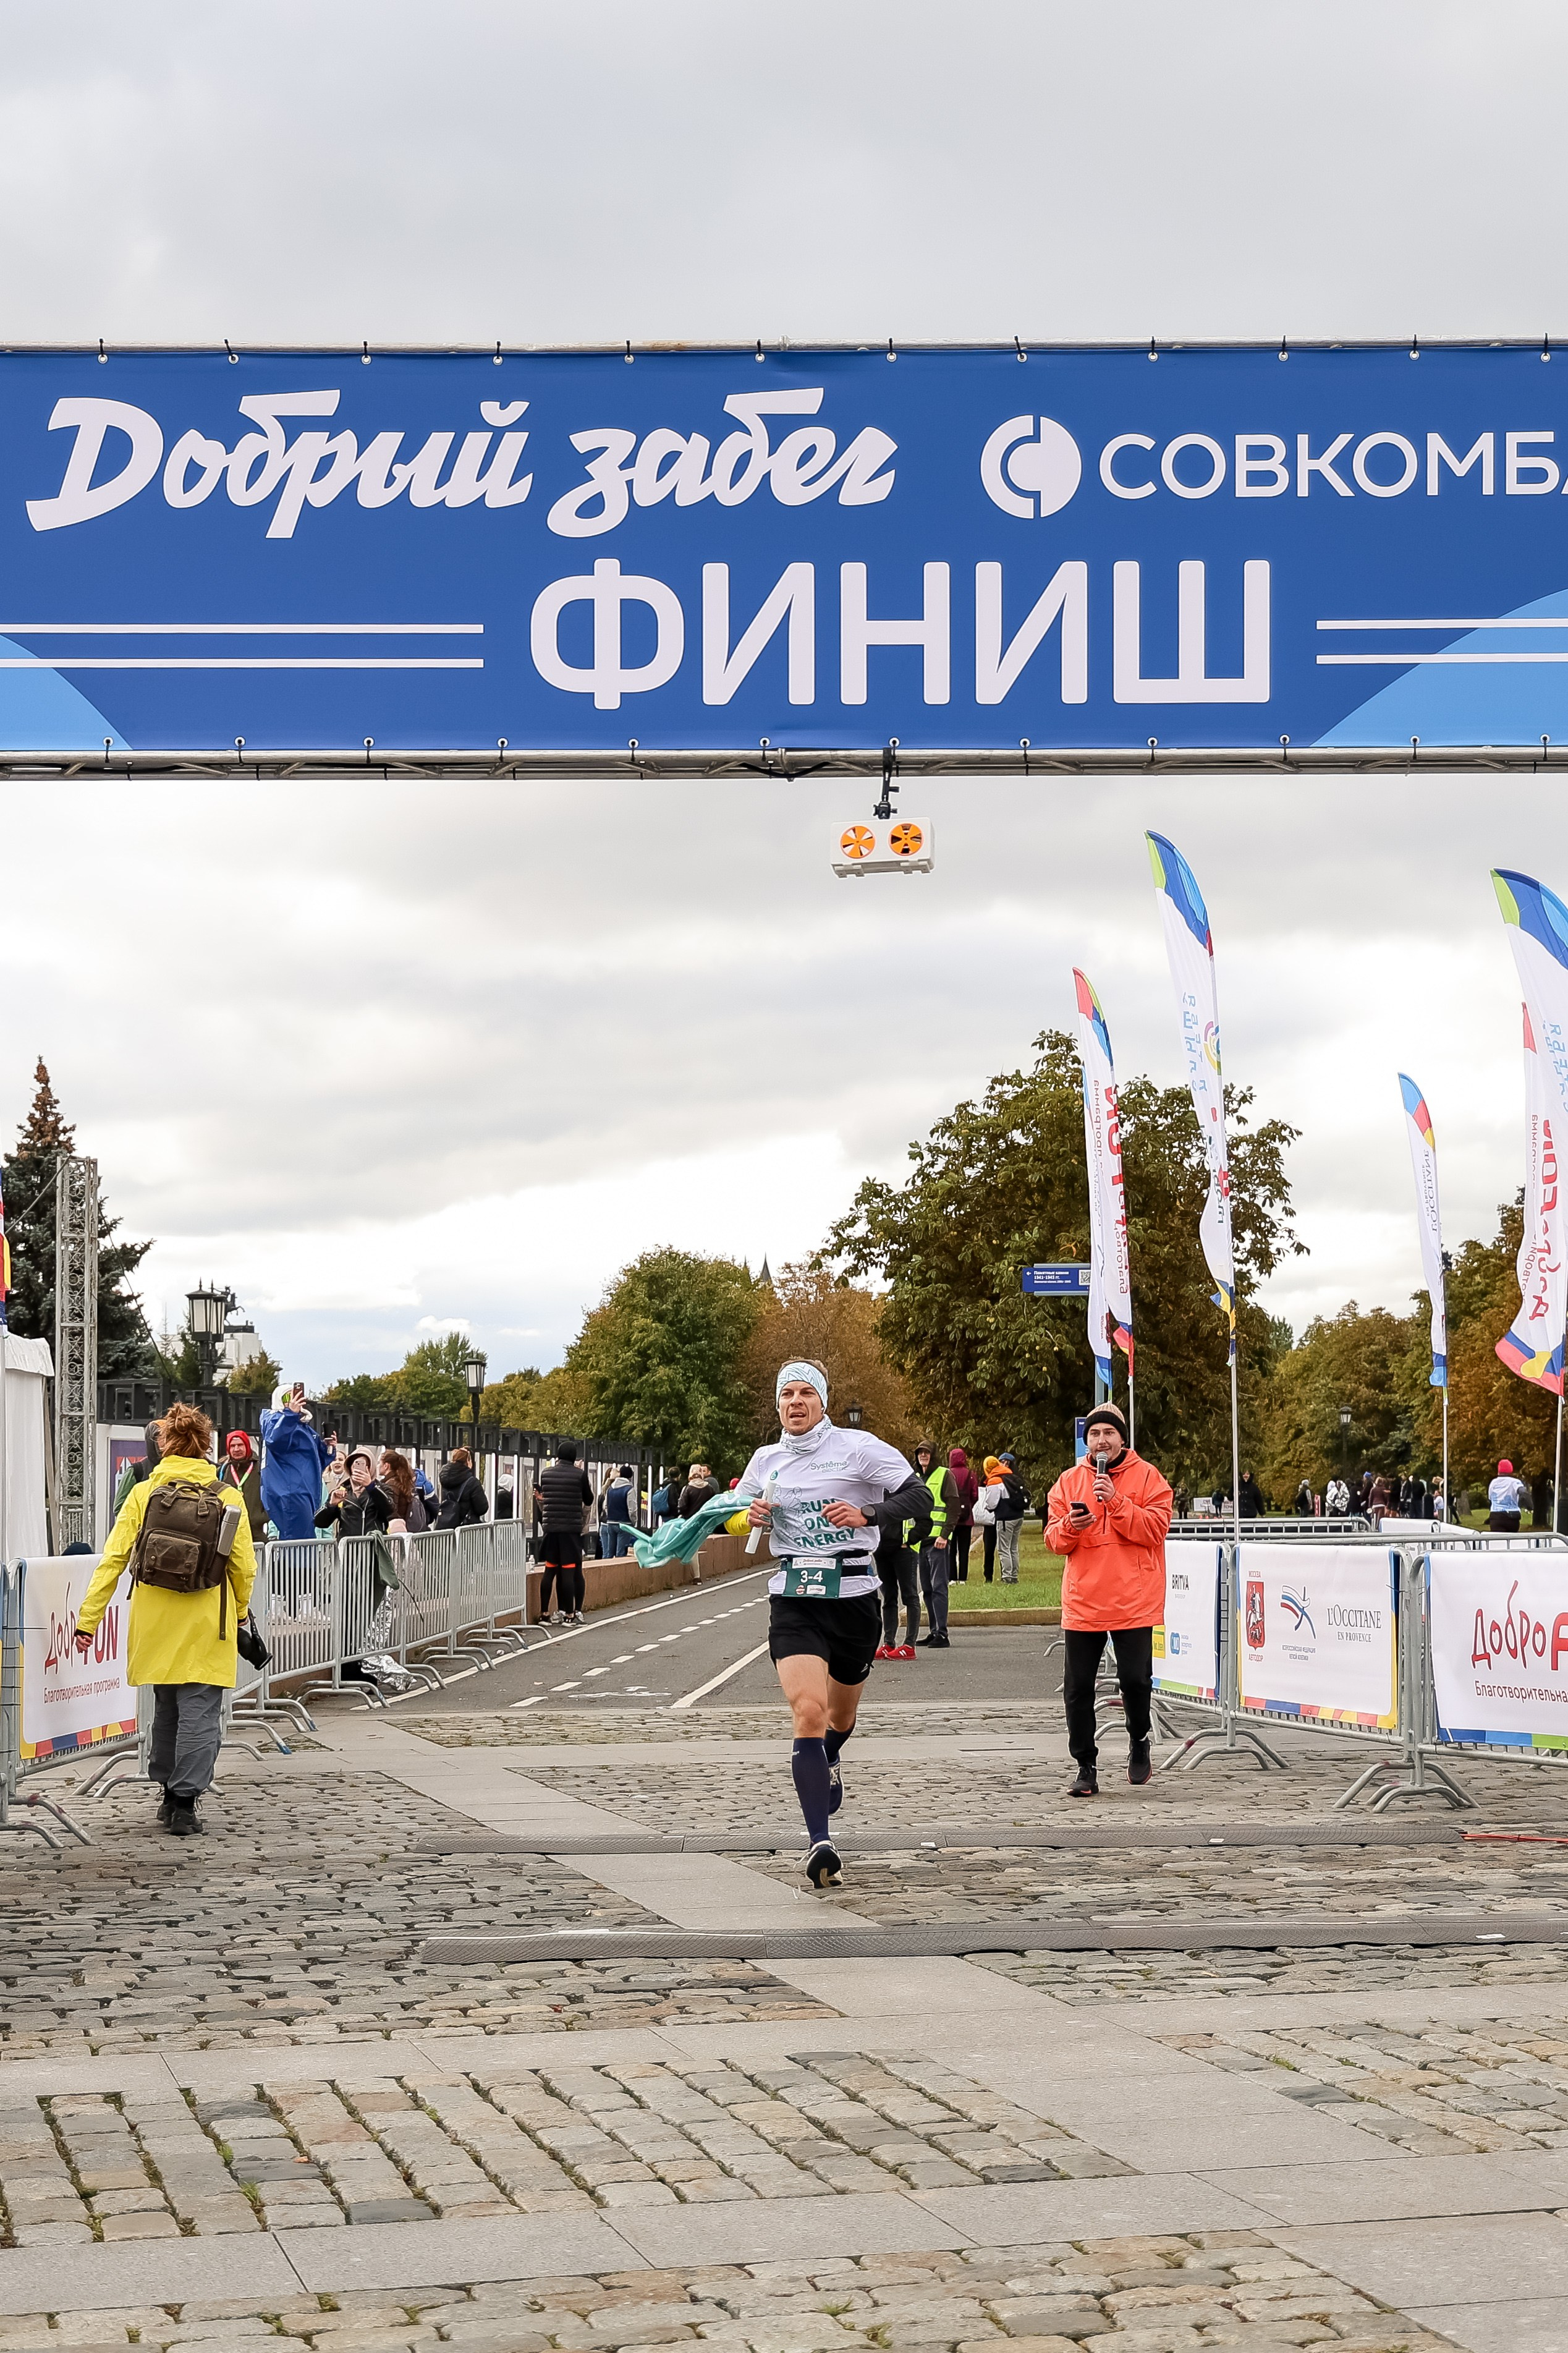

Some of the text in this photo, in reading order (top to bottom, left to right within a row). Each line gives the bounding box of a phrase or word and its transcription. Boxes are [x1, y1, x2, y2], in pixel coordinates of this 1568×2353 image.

[26, 388, 898, 538] Добрый забег
[1100, 432, 1568, 500] СОВКОМБ
[530, 558, 1271, 709] ФИНИШ
[810, 1461, 847, 1470] Système
[800, 1570, 823, 1583] 3-4
[44, 1581, 119, 1675] ДобрON
[1328, 1604, 1382, 1628] L'OCCITANE
[1337, 1632, 1371, 1643] EN PROVENCE
[44, 1677, 121, 1703] Благотворительная программа
[1475, 1680, 1568, 1703] Благотворительна
